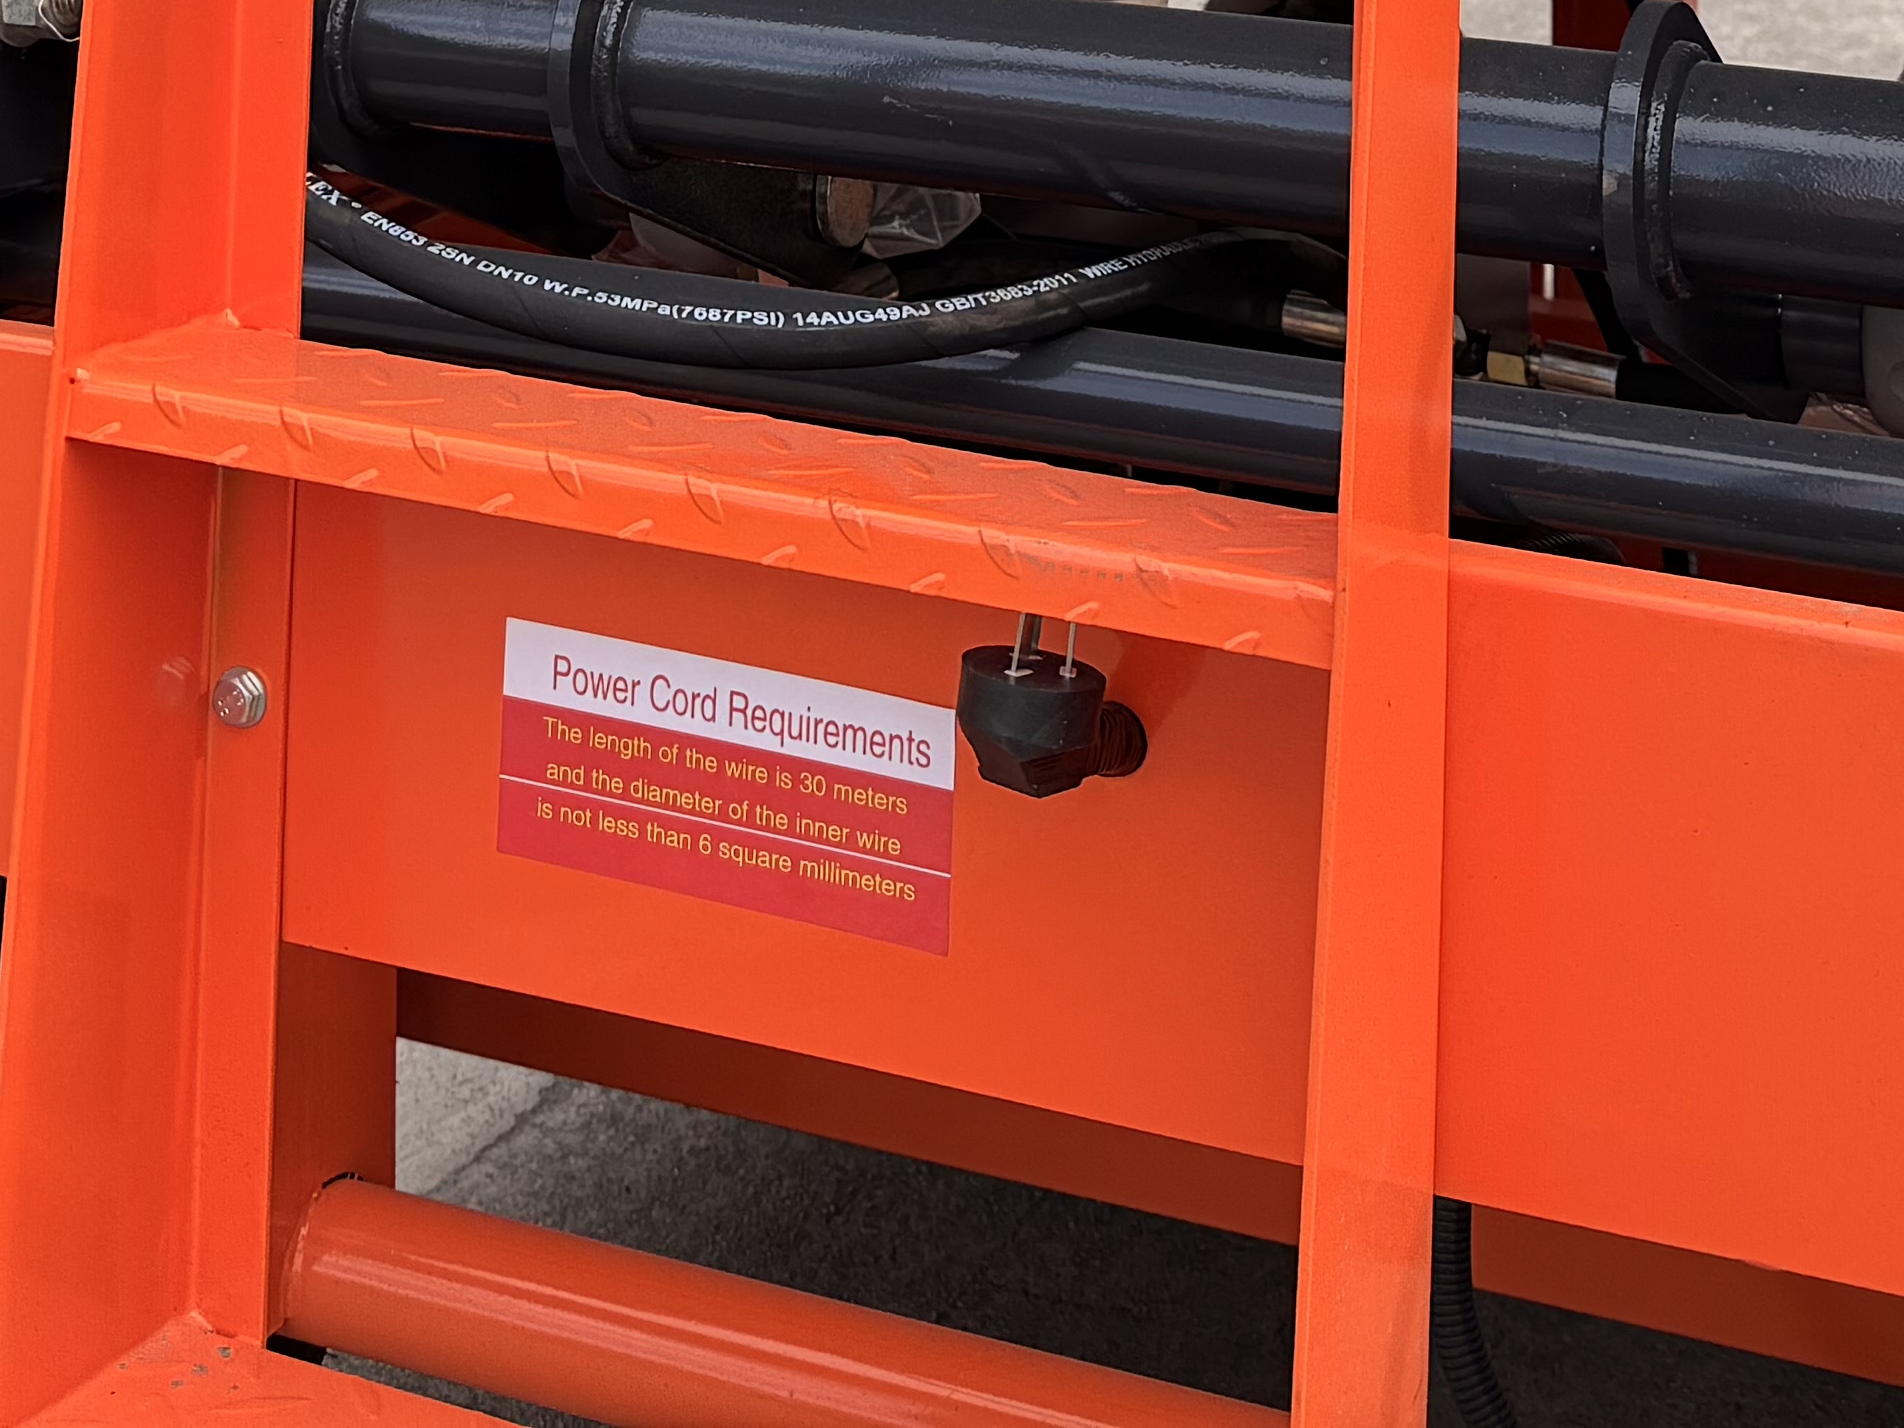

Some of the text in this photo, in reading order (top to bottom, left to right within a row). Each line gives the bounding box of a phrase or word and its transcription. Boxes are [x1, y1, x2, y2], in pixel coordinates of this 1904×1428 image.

[426, 241, 476, 266] 2SN
[476, 259, 539, 286] DN10
[1078, 257, 1129, 279] WIRE
[552, 654, 931, 769] Power Cord Requirements
[543, 716, 908, 815] The length of the wire is 30 meters
[546, 762, 901, 855] and the diameter of the inner wire
[537, 796, 916, 902] is not less than 6 square millimeters
